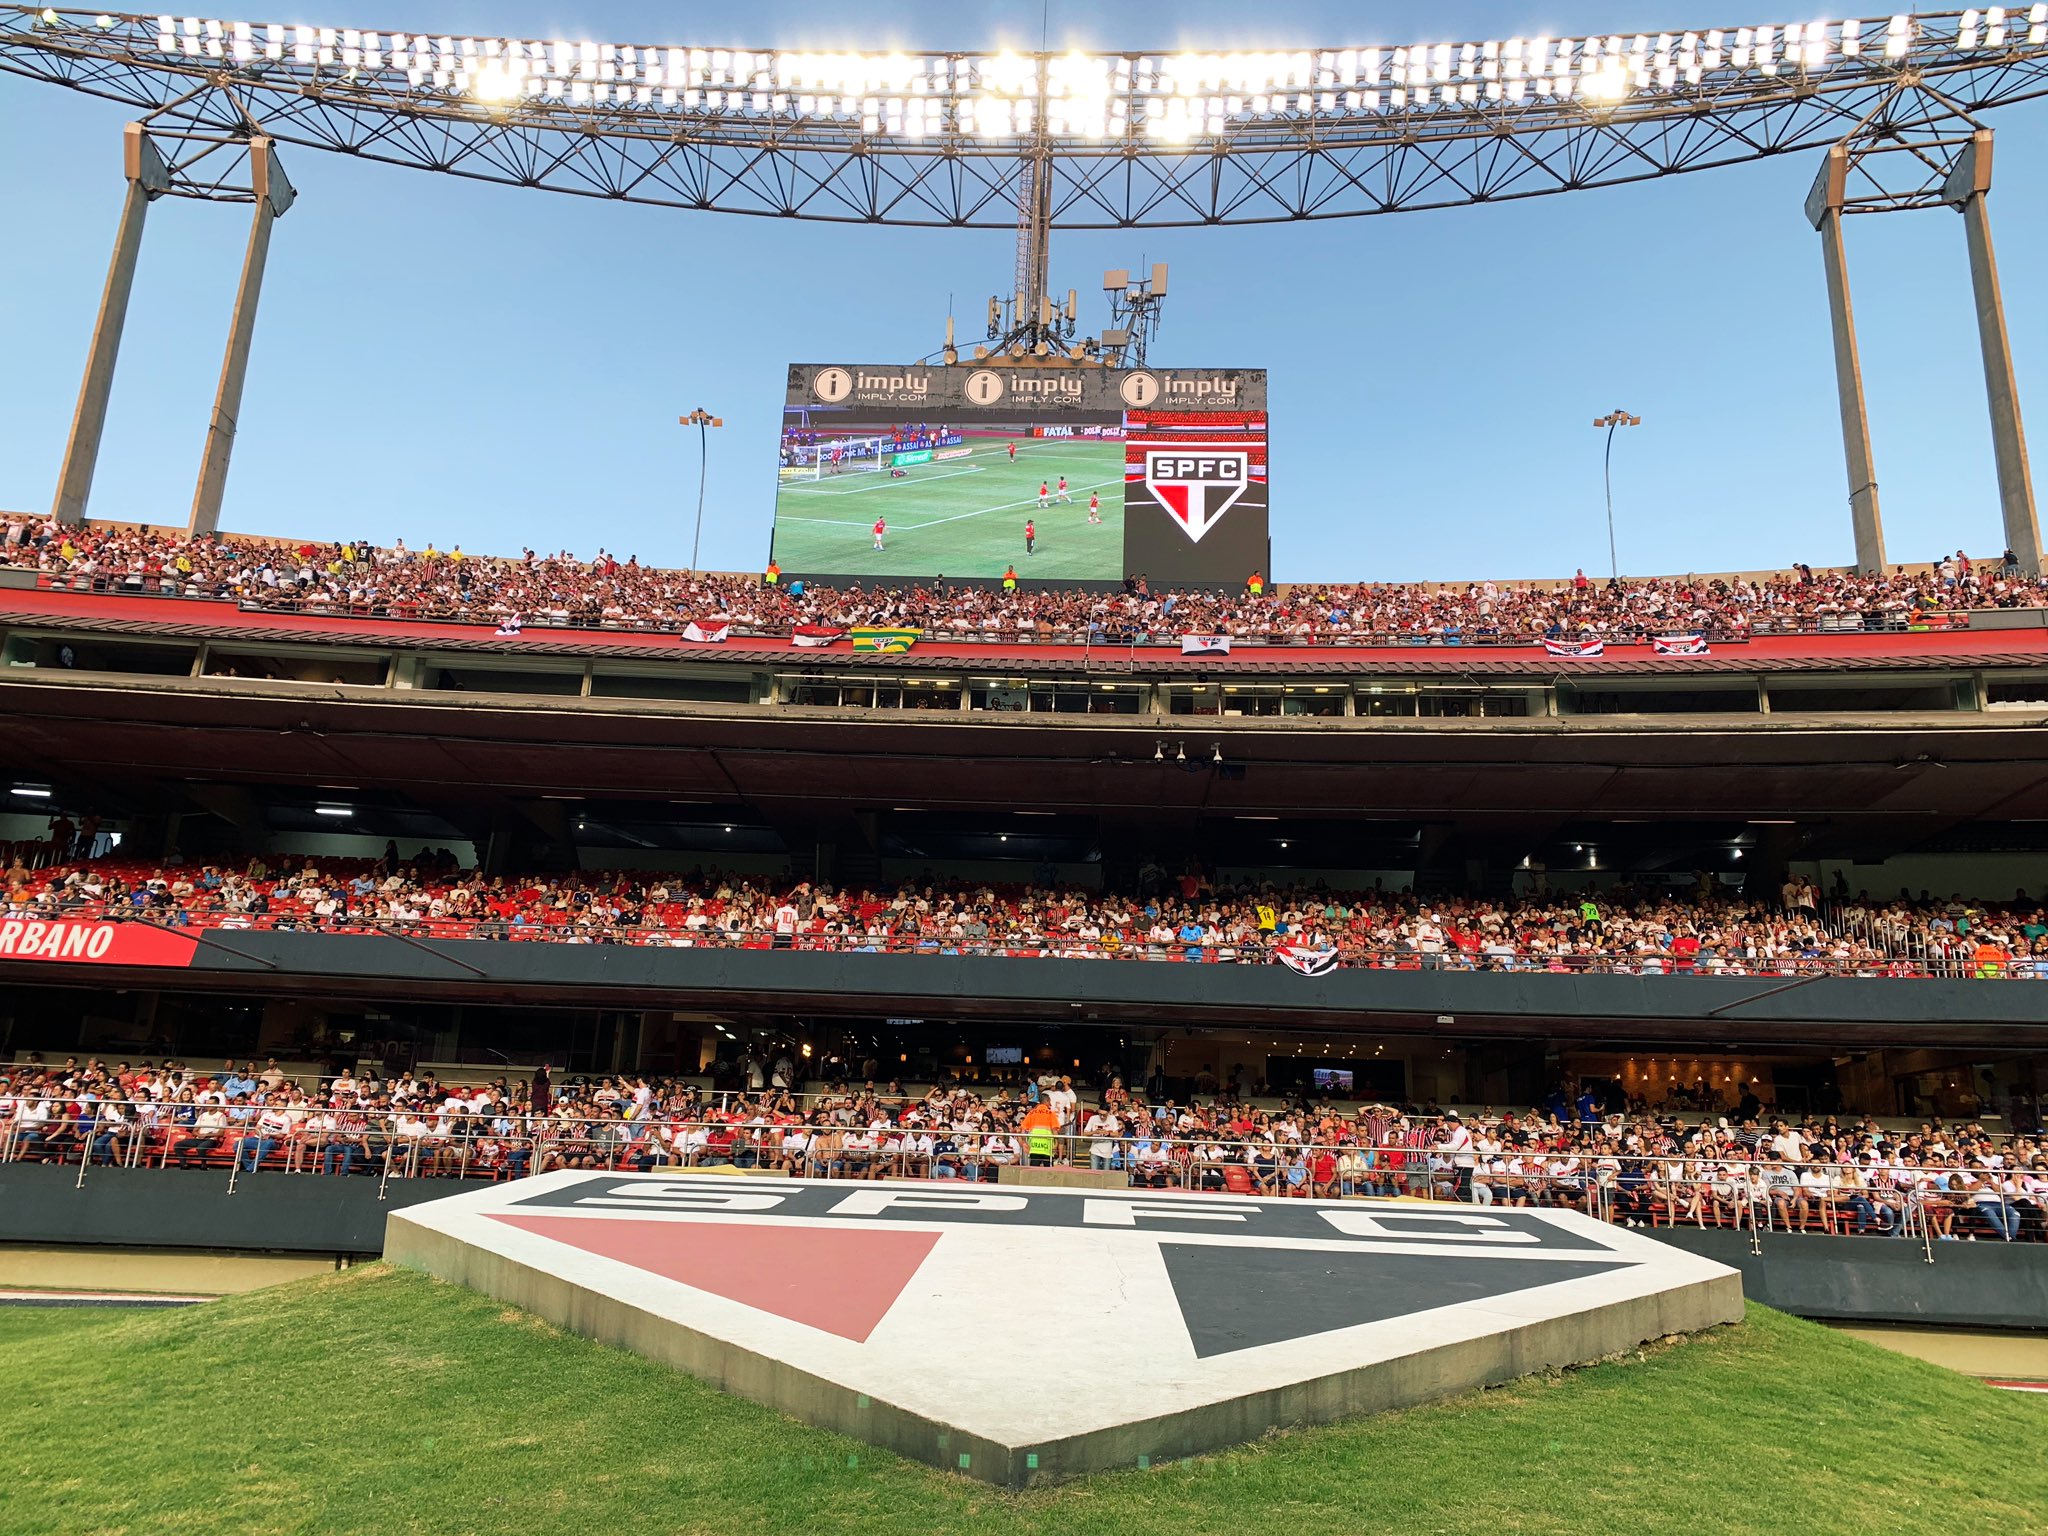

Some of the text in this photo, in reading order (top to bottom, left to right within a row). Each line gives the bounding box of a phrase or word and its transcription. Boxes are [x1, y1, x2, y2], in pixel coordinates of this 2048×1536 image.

[858, 372, 928, 394] imply
[1011, 374, 1082, 396] imply
[1164, 376, 1236, 397] imply
[858, 393, 927, 401] IMPLY.COM
[1165, 397, 1236, 405] IMPLY.COM
[1157, 460, 1237, 478] SPFC
[0, 921, 114, 958] RBANO
[573, 1182, 1542, 1243] SPFC
